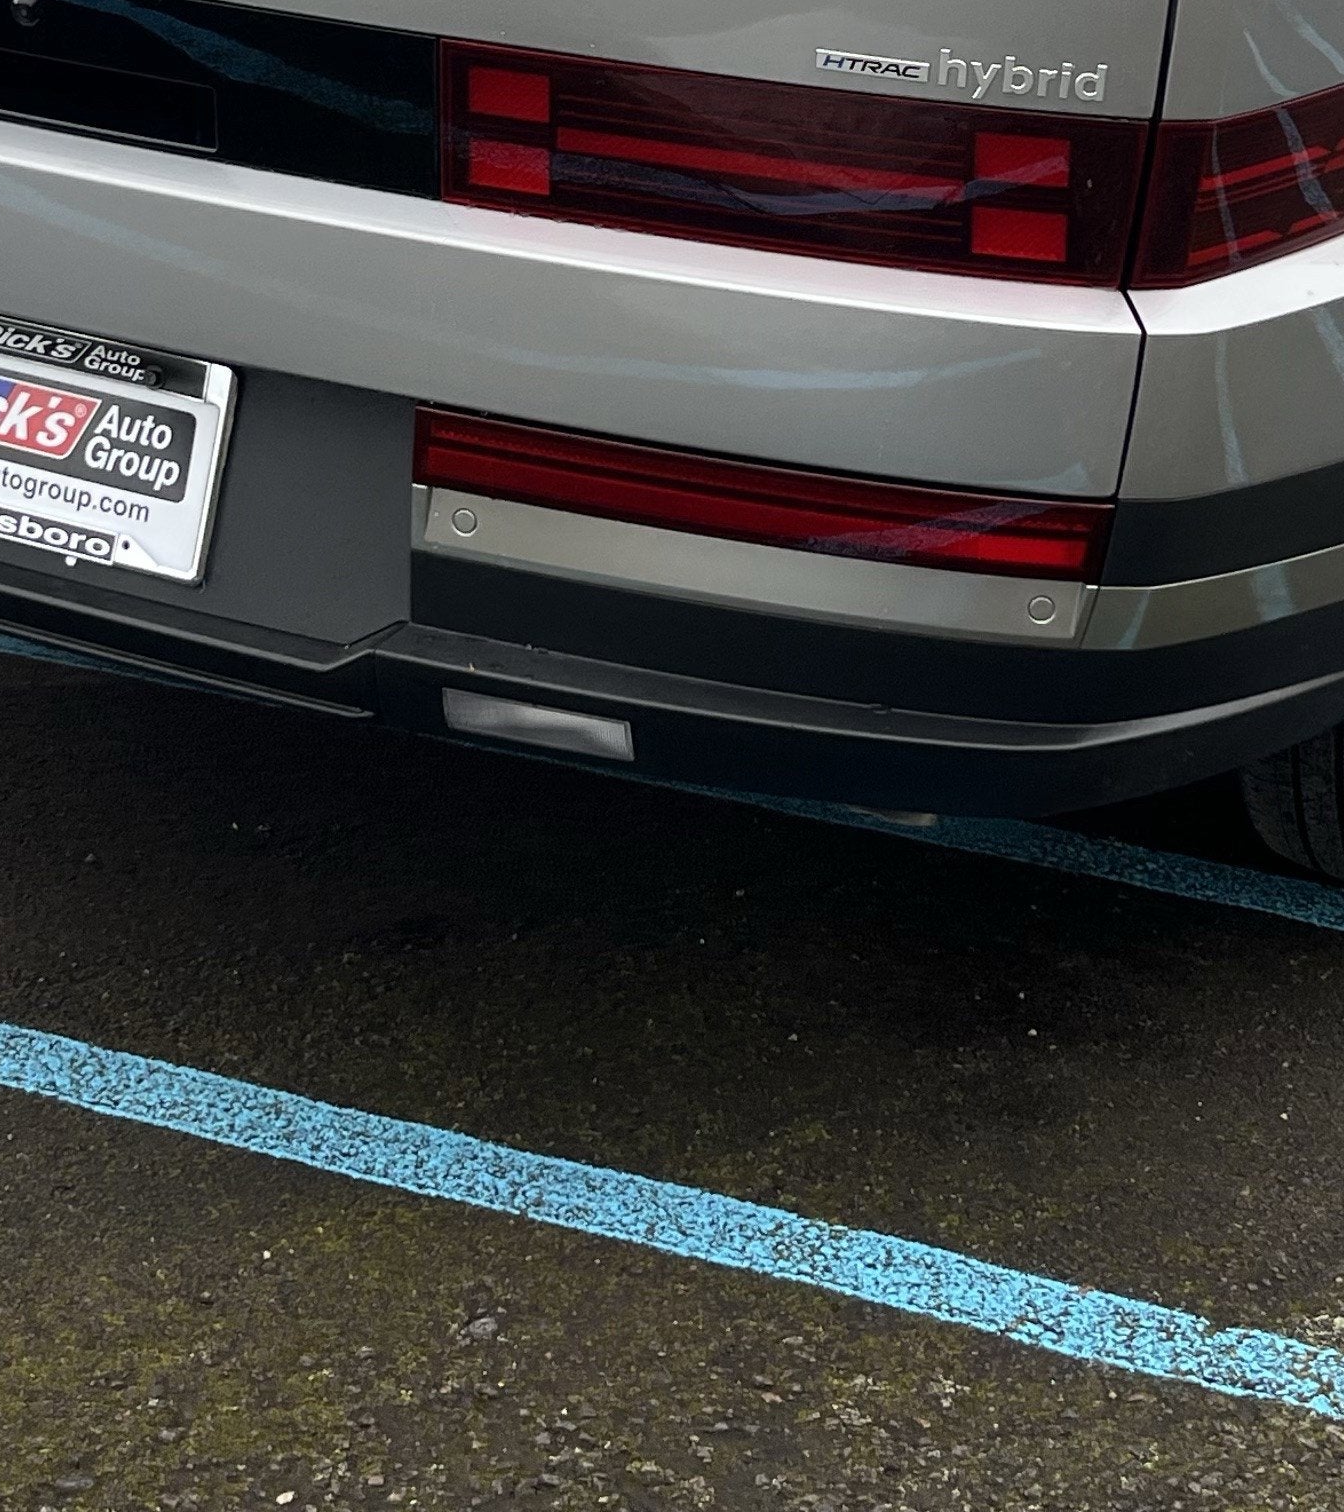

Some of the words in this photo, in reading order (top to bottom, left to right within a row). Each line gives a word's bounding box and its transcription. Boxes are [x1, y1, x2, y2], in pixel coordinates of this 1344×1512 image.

[821, 54, 922, 80] HTRAC
[937, 47, 1108, 103] hybrid
[83, 355, 145, 383] Group
[90, 344, 142, 367] Auto
[93, 404, 173, 450] Auto
[84, 436, 181, 491] Group
